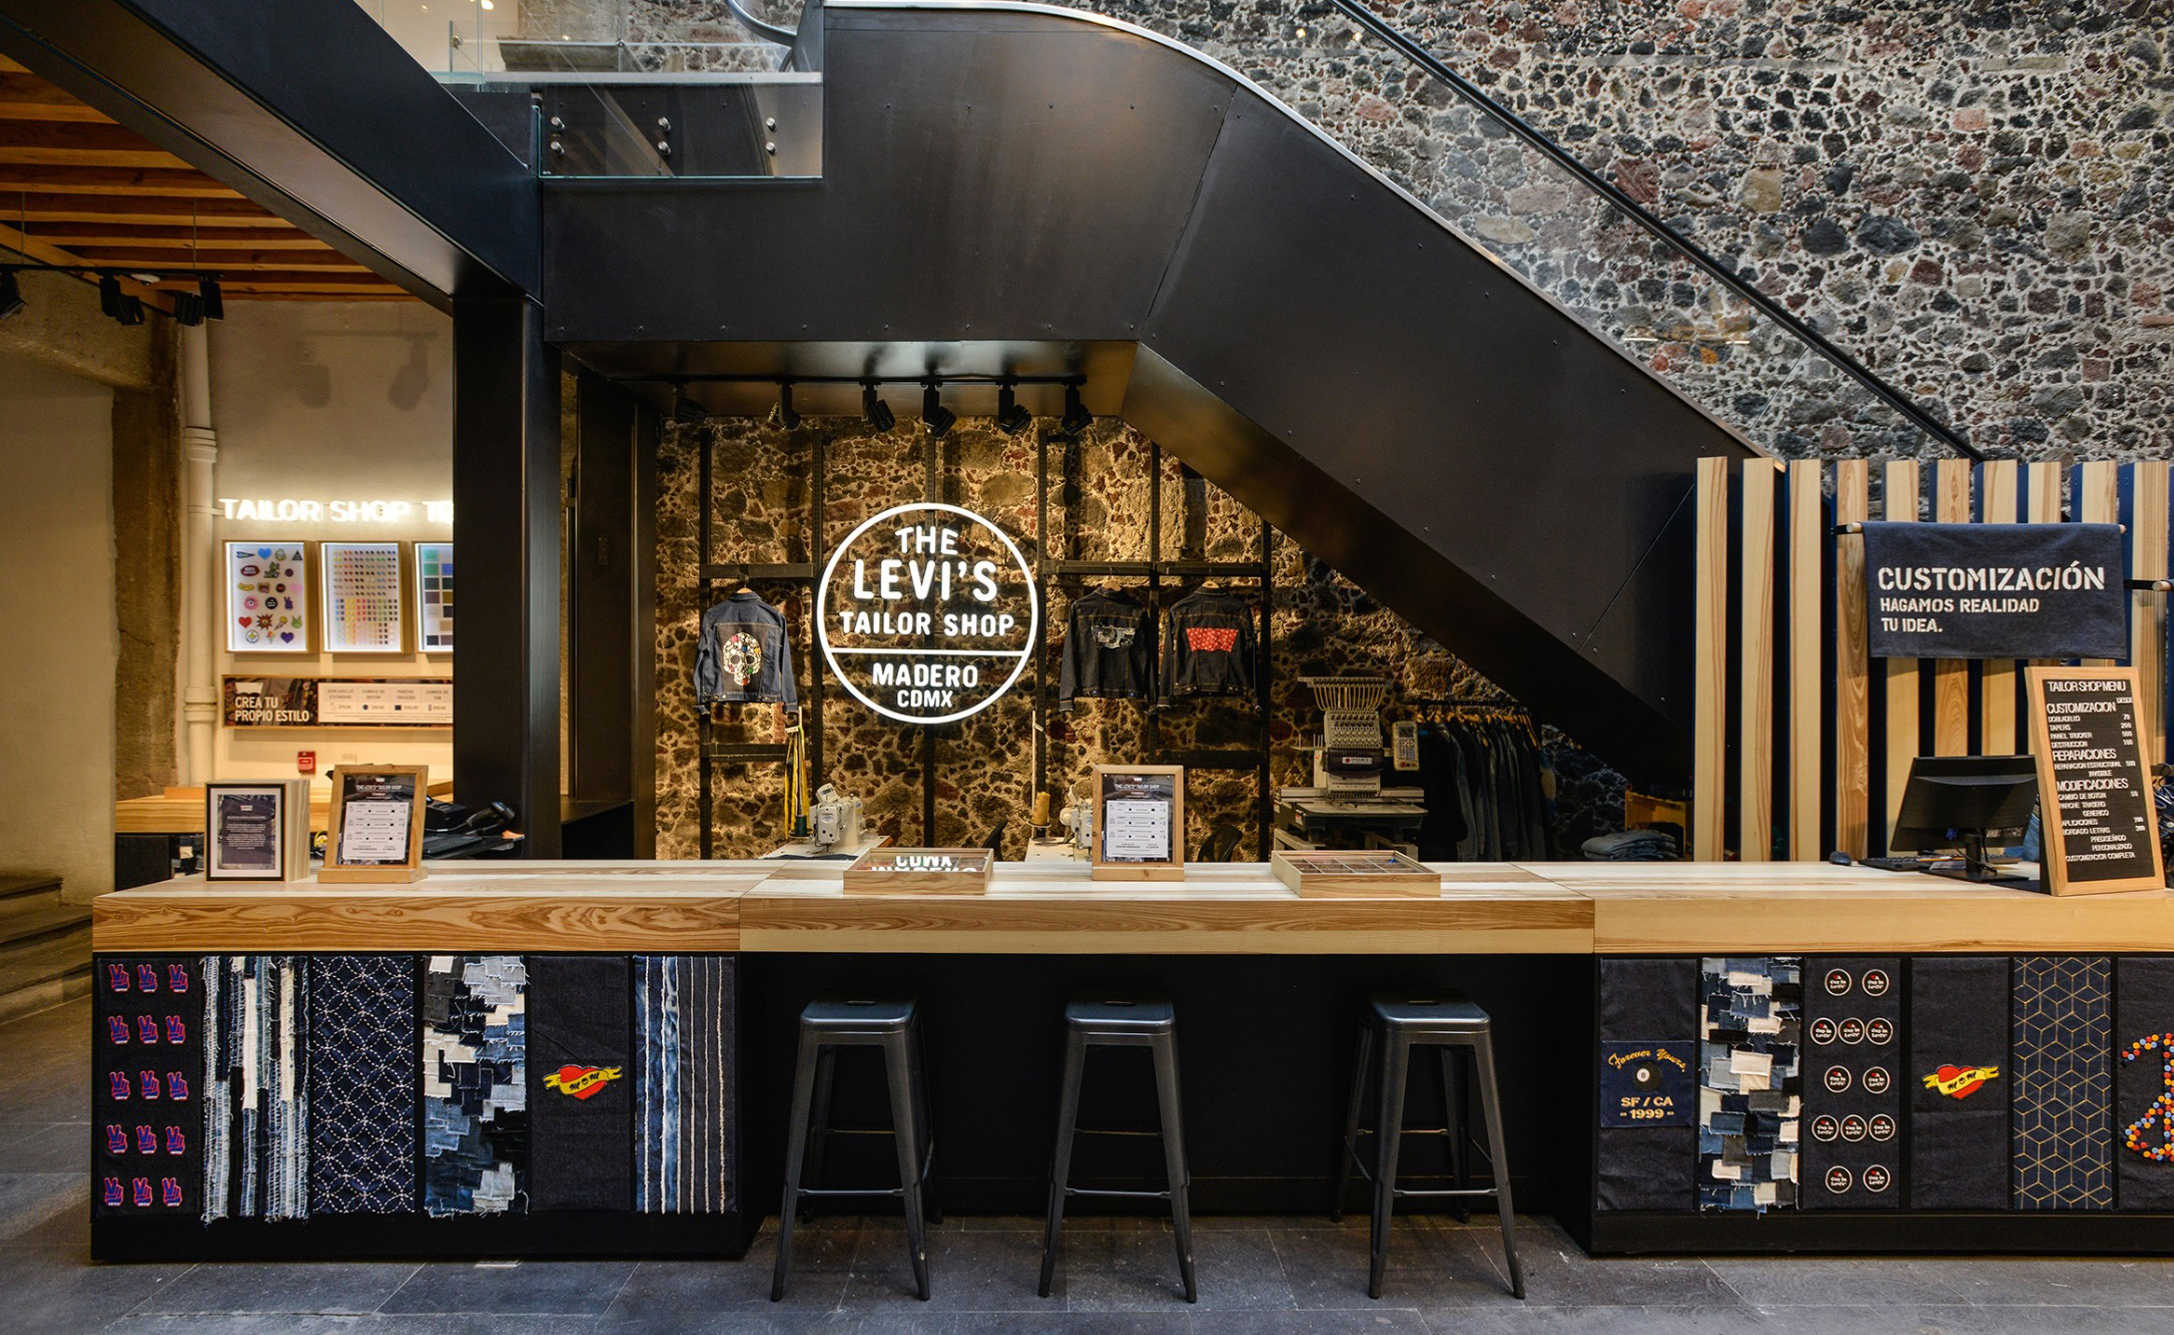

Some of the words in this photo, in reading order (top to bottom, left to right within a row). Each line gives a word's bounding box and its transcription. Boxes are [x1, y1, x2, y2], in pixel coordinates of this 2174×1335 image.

[218, 498, 321, 522] TAILOR
[330, 500, 411, 523] SHOP
[895, 525, 959, 555] THE
[853, 558, 998, 602] LEVI'S
[1877, 560, 2105, 591] CUSTOMIZACIÓN
[1880, 598, 1954, 613] HAGAMOS
[1959, 598, 2040, 613] REALIDAD
[839, 611, 931, 635] TAILOR
[943, 613, 1015, 637] SHOP
[1881, 617, 1899, 632] TU
[1902, 617, 1943, 633] IDEA.
[872, 663, 978, 688] MADERO
[2046, 681, 2078, 692] TAILOR
[2079, 681, 2102, 692] SHOP
[2103, 681, 2126, 692] MENU
[235, 696, 262, 709] CREA
[264, 696, 279, 708] TU
[897, 690, 953, 708] CDMX
[235, 709, 273, 722] PROPIO
[275, 709, 310, 722] ESTILO
[2046, 702, 2116, 714] CUSTOMIZACION
[2052, 748, 2117, 761] REPARACIONES
[2057, 778, 2129, 792] MODIFICACIONES
[1607, 1050, 1651, 1069] Forever
[1620, 1096, 1641, 1107] SF
[1643, 1096, 1651, 1107] /
[1653, 1096, 1674, 1107] CA
[1629, 1108, 1664, 1119] 1999
